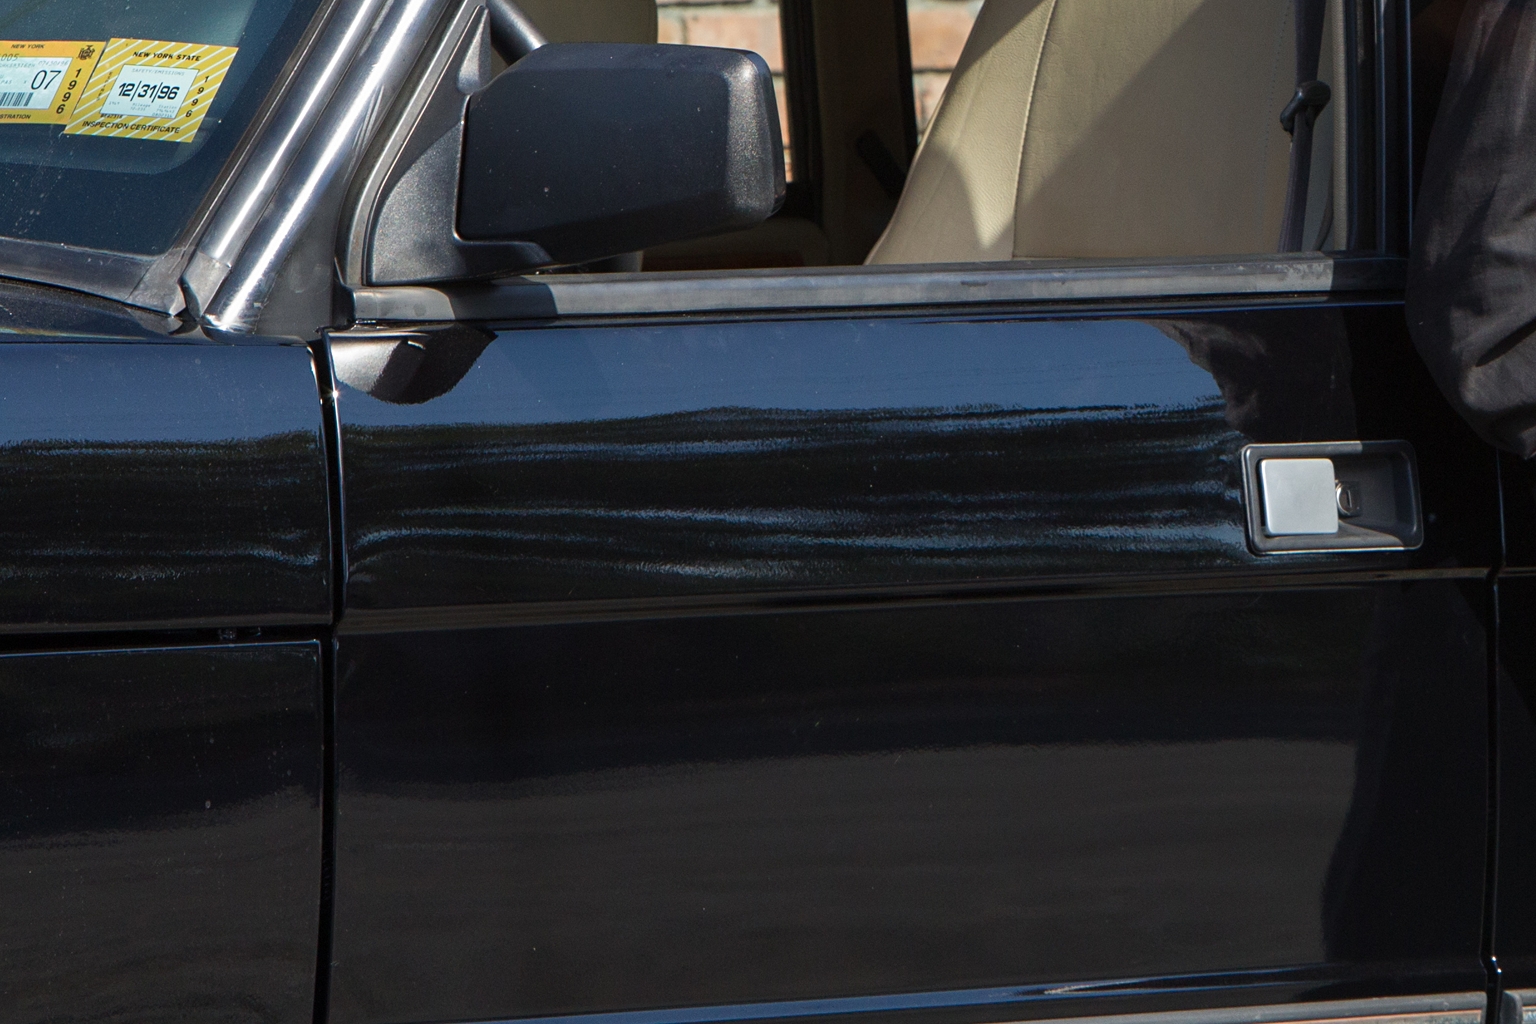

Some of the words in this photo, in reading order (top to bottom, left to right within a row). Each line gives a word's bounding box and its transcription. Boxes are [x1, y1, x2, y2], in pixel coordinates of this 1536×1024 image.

[0, 54, 20, 62] 005
[30, 69, 62, 91] 07
[118, 80, 180, 103] 12/31/96
[82, 119, 129, 131] INSPECTION
[130, 123, 181, 134] CERTIFICATE
